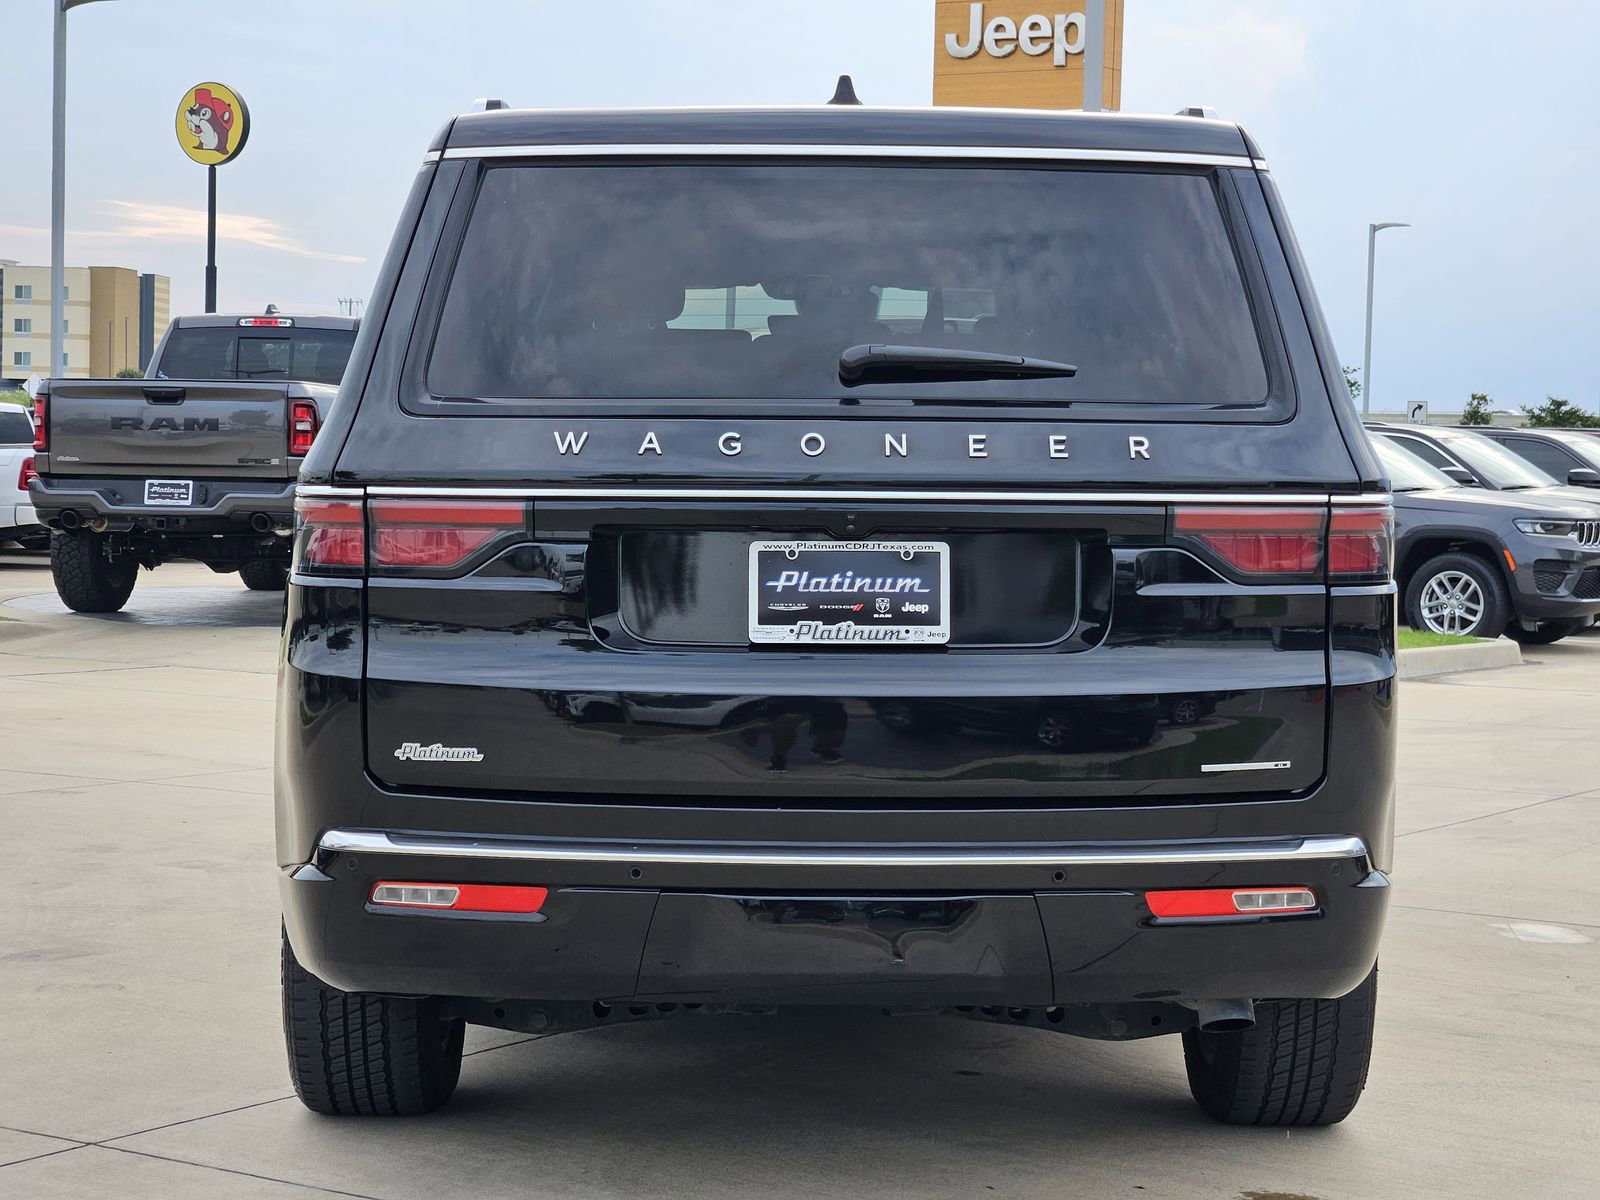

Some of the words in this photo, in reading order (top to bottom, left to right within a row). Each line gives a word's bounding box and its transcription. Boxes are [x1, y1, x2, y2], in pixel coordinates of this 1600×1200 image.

[945, 3, 1086, 67] Jeep
[110, 416, 219, 432] RAM
[553, 431, 1151, 459] WAGONEER
[762, 542, 934, 551] www.PlatinumCDRJTexas.com
[765, 570, 930, 592] Platinum
[901, 601, 929, 614] Jeep
[795, 622, 910, 641] Platinum
[927, 631, 947, 639] Jeep
[394, 742, 485, 762] Platinum
